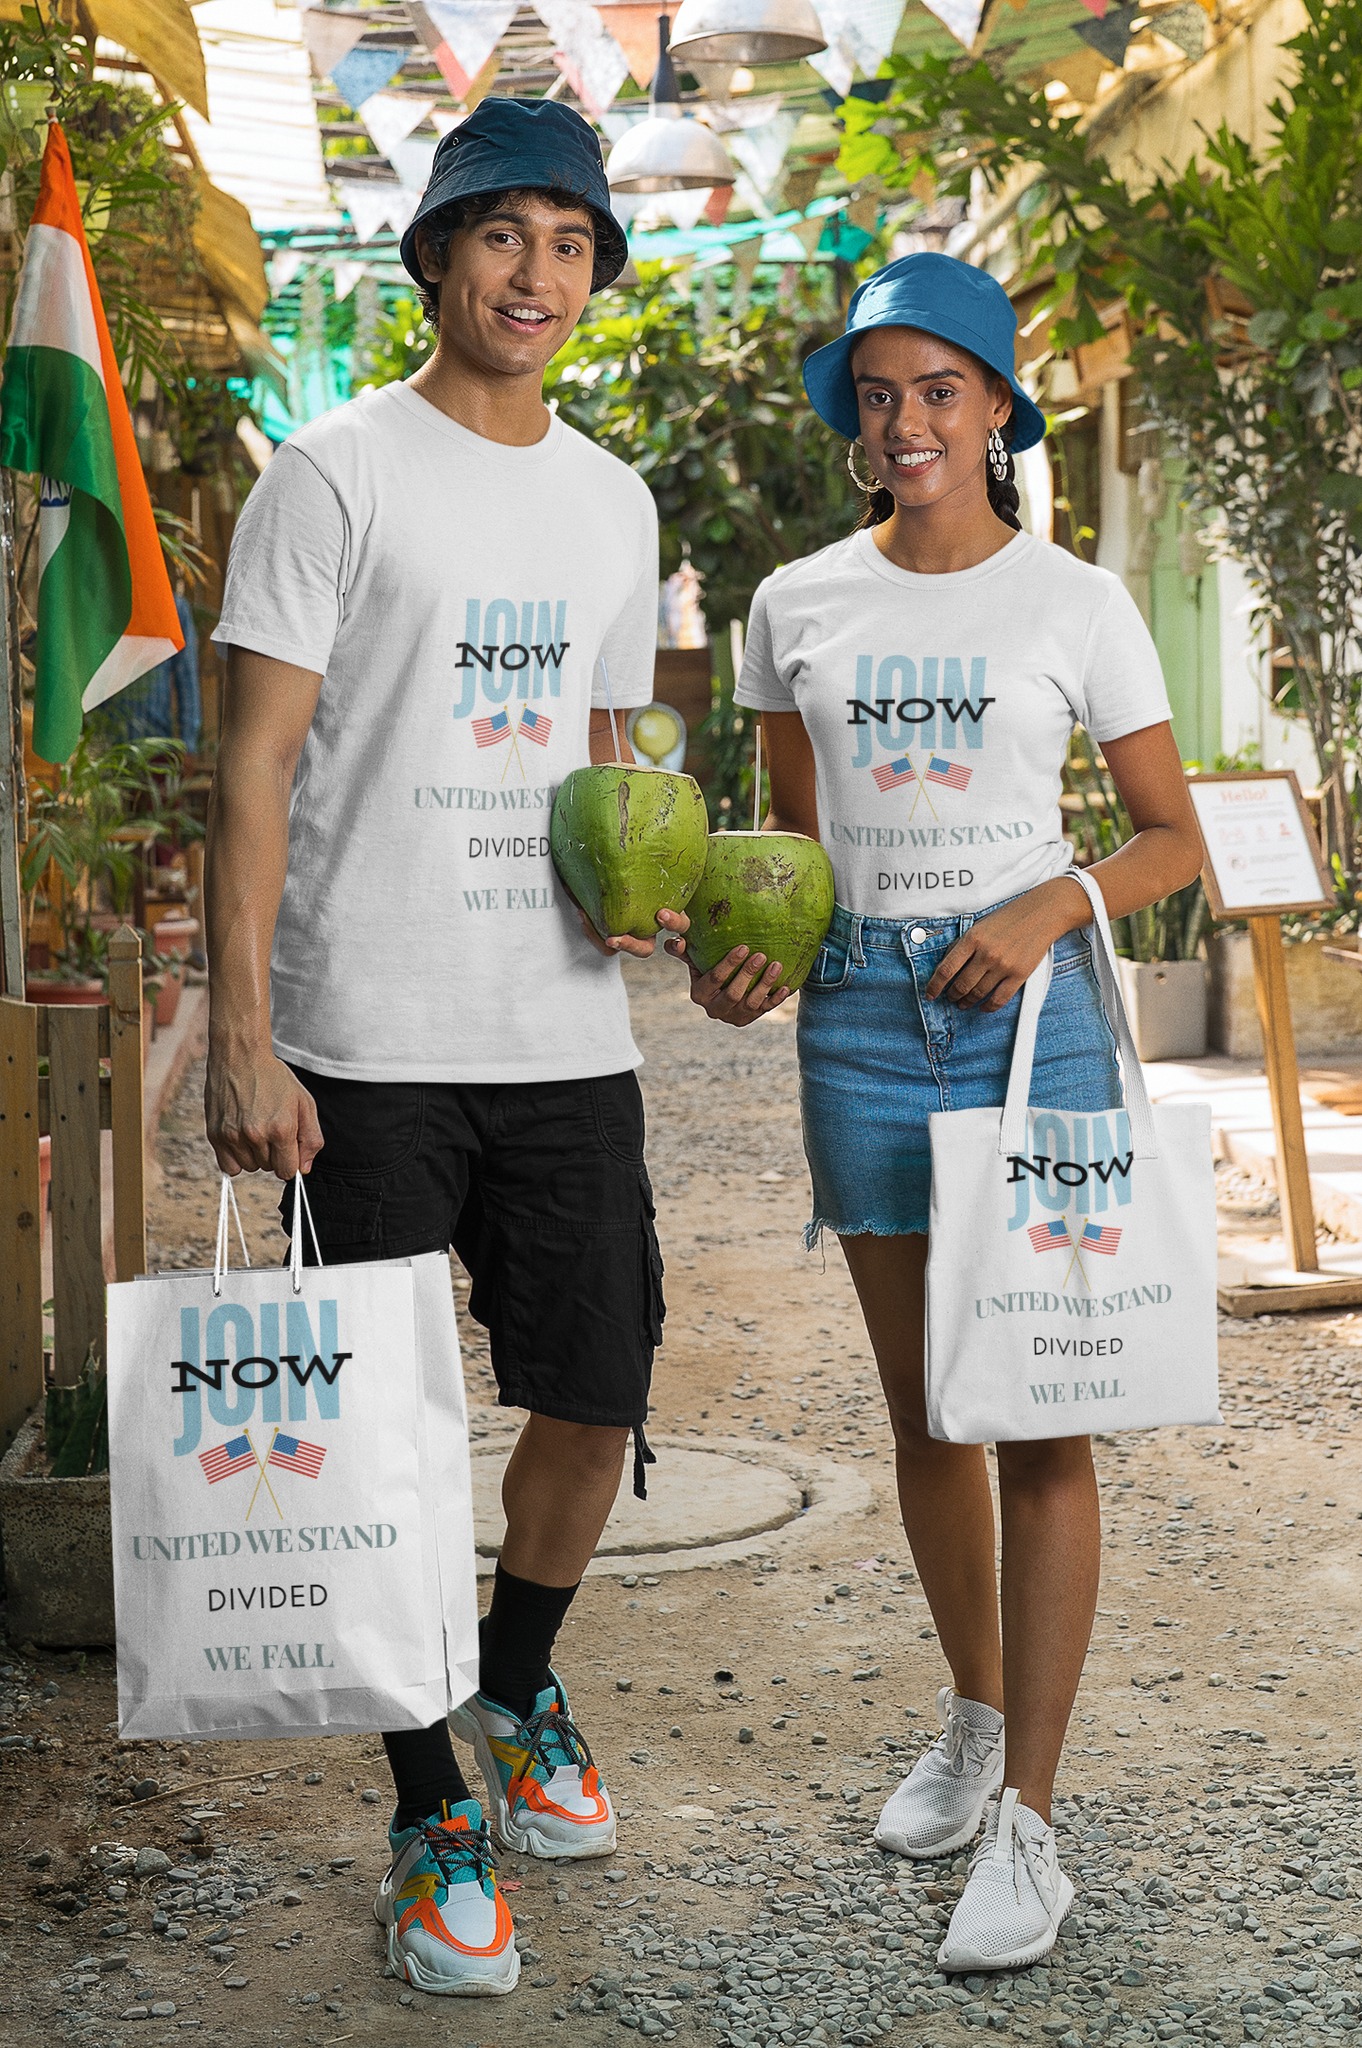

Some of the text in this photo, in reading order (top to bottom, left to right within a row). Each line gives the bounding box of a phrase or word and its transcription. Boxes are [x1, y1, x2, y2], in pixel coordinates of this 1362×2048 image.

[453, 598, 567, 719] JOIN
[454, 642, 570, 672] NOW
[846, 698, 996, 724] NOW
[851, 655, 986, 768] JOIN
[414, 785, 497, 811] UNITED
[500, 788, 532, 811] WE
[468, 837, 550, 858] DIVIDED
[829, 820, 1034, 848] UNITED WE STAND
[878, 870, 974, 891] DIVIDED
[462, 888, 554, 911] WE FALL
[1006, 1151, 1134, 1187] NOW
[1007, 1110, 1132, 1232] JOIN
[975, 1283, 1172, 1319] UNITED WE STAND
[1034, 1337, 1124, 1356] DIVIDED
[171, 1352, 352, 1392] NOW
[173, 1299, 340, 1457] JOIN
[1029, 1379, 1126, 1405] WE FALL
[131, 1523, 397, 1561] UNITED WE STAND
[208, 1584, 328, 1611] DIVIDED
[203, 1643, 335, 1672] WE FALL
